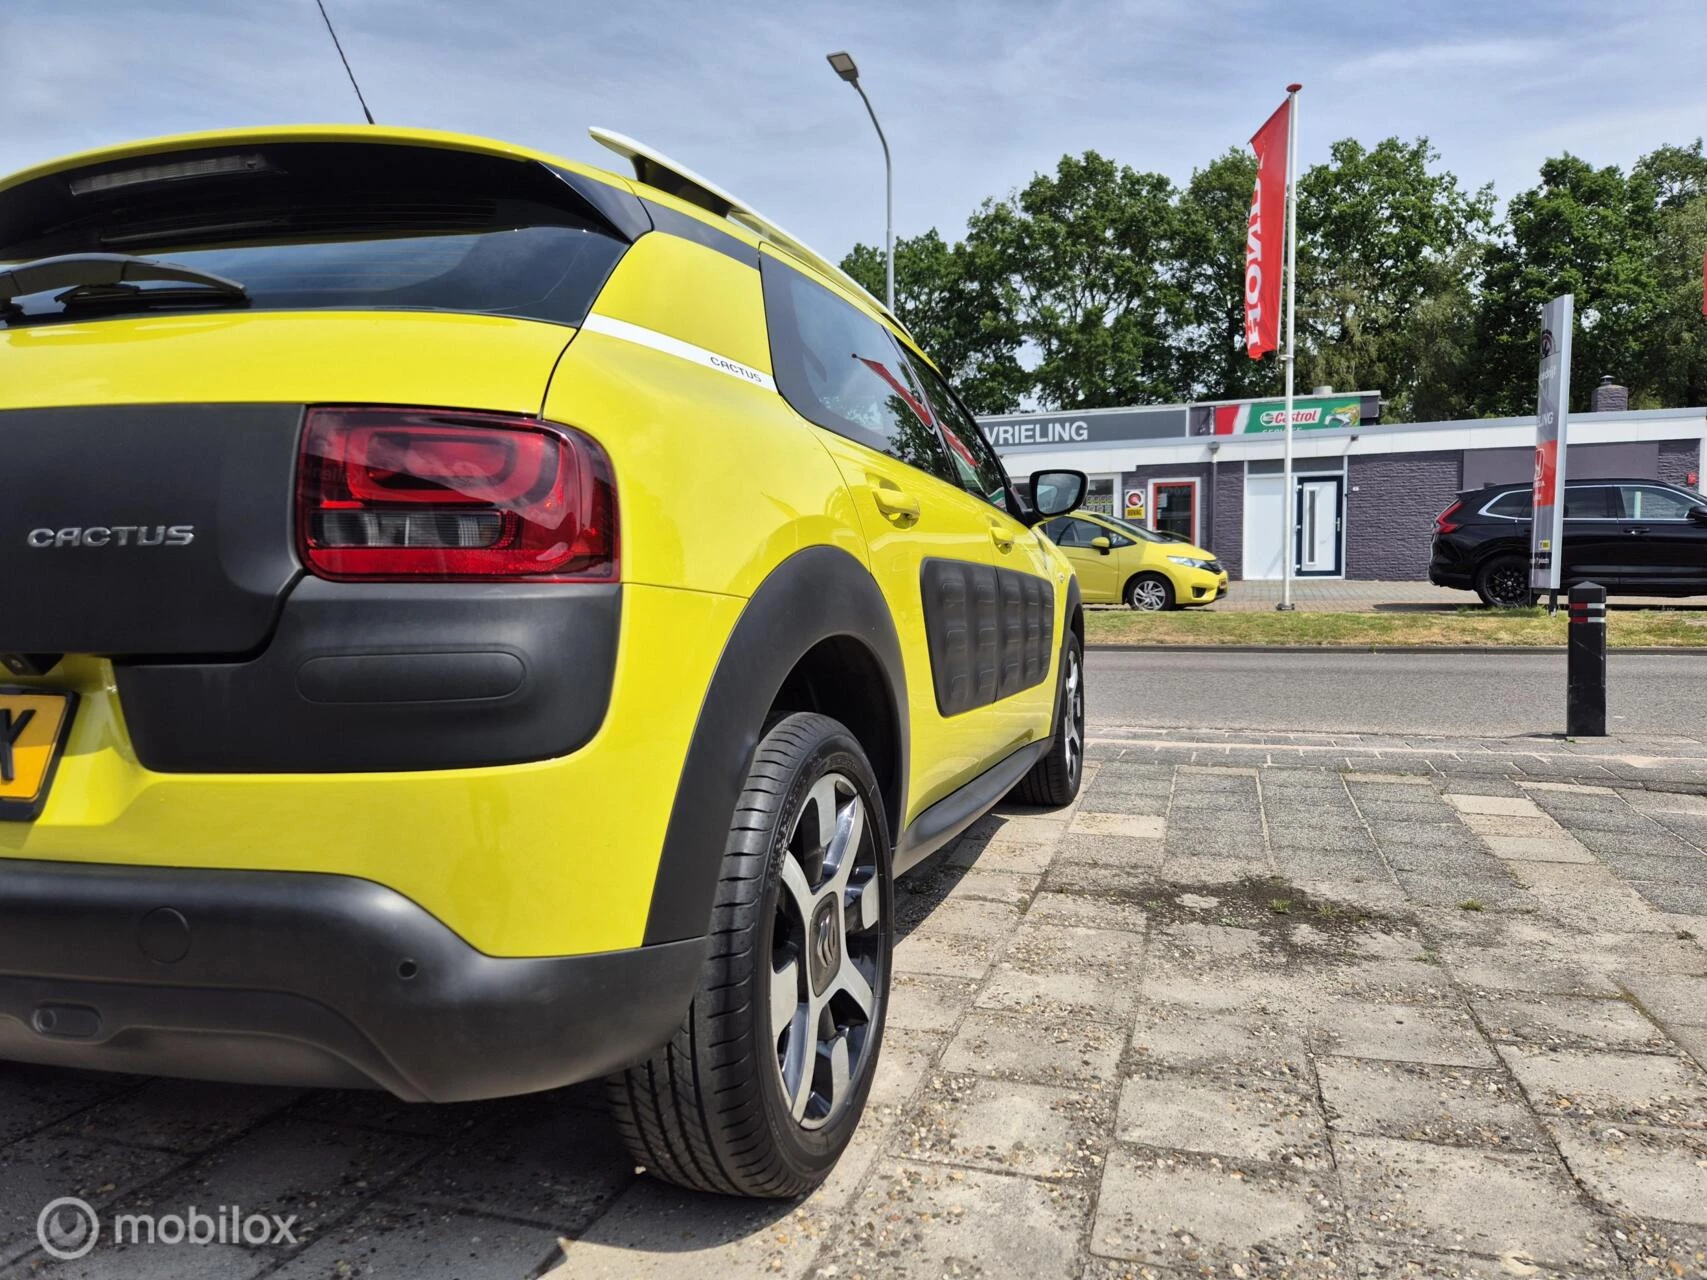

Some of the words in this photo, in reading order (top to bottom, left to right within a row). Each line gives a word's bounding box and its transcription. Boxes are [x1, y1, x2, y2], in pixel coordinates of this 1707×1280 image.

[710, 356, 762, 383] CACTUS
[984, 421, 1088, 445] VRIELING
[27, 525, 195, 547] CACTUS
